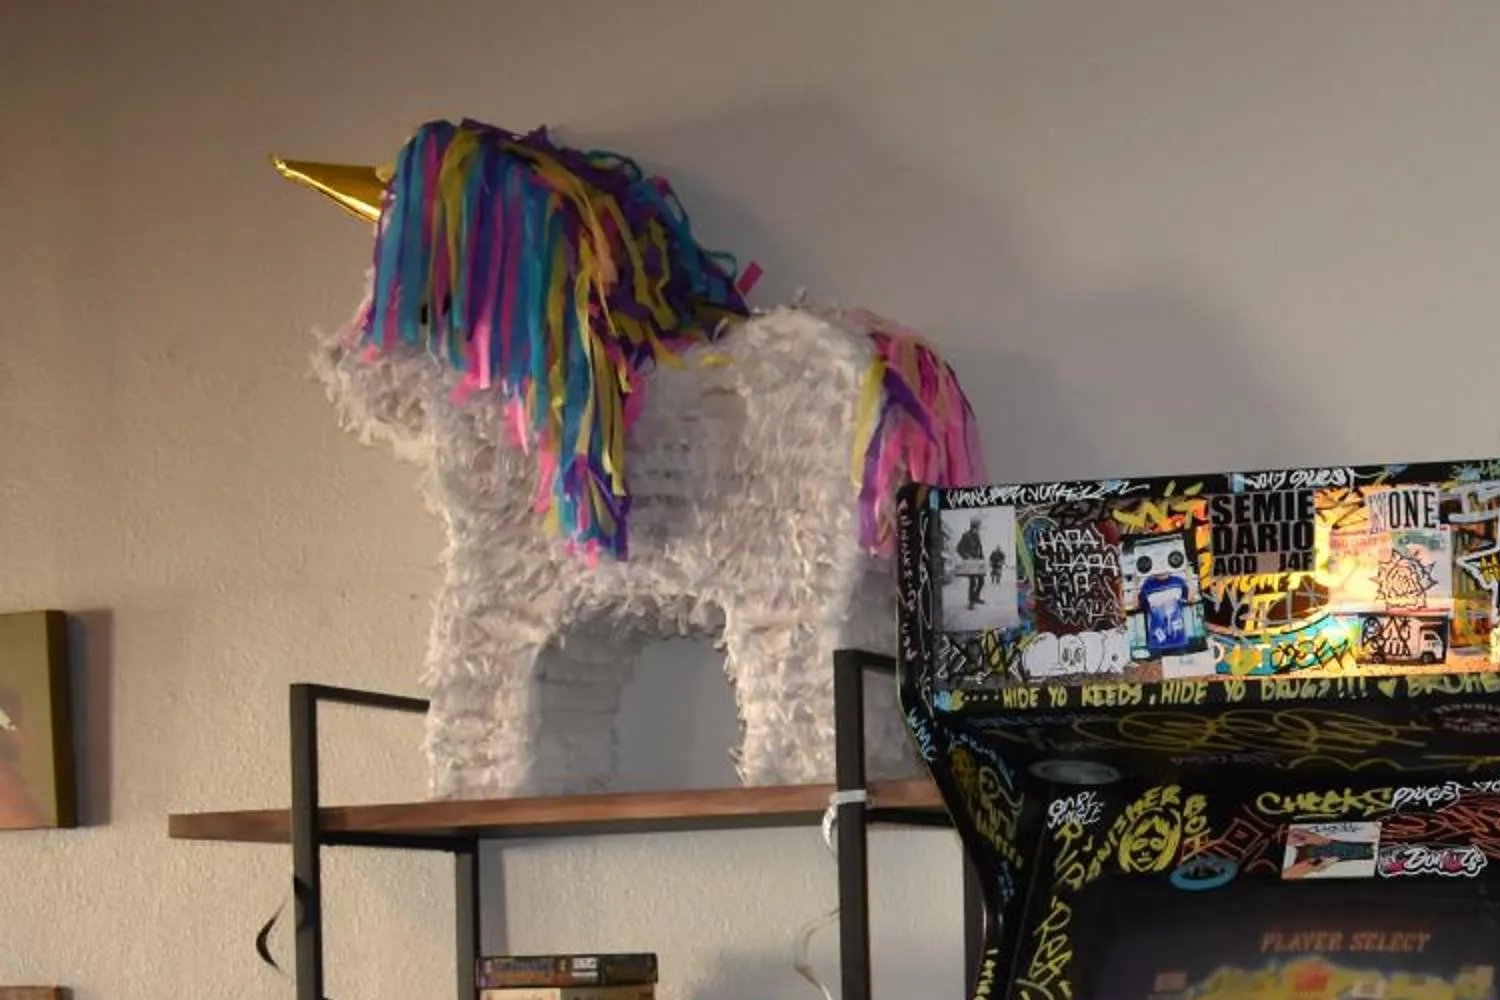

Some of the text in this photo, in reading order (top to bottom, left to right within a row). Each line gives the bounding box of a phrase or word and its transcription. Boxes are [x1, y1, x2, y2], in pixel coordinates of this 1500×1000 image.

[1212, 490, 1314, 524] SEMIE
[1212, 521, 1314, 555] DARIO
[1213, 554, 1258, 576] AOD
[1003, 686, 1041, 709] HIDE
[1048, 683, 1068, 708] YO
[1160, 679, 1209, 705] HIDE
[1224, 679, 1247, 703] YO
[1260, 931, 1433, 954] PLAYER SELECT
